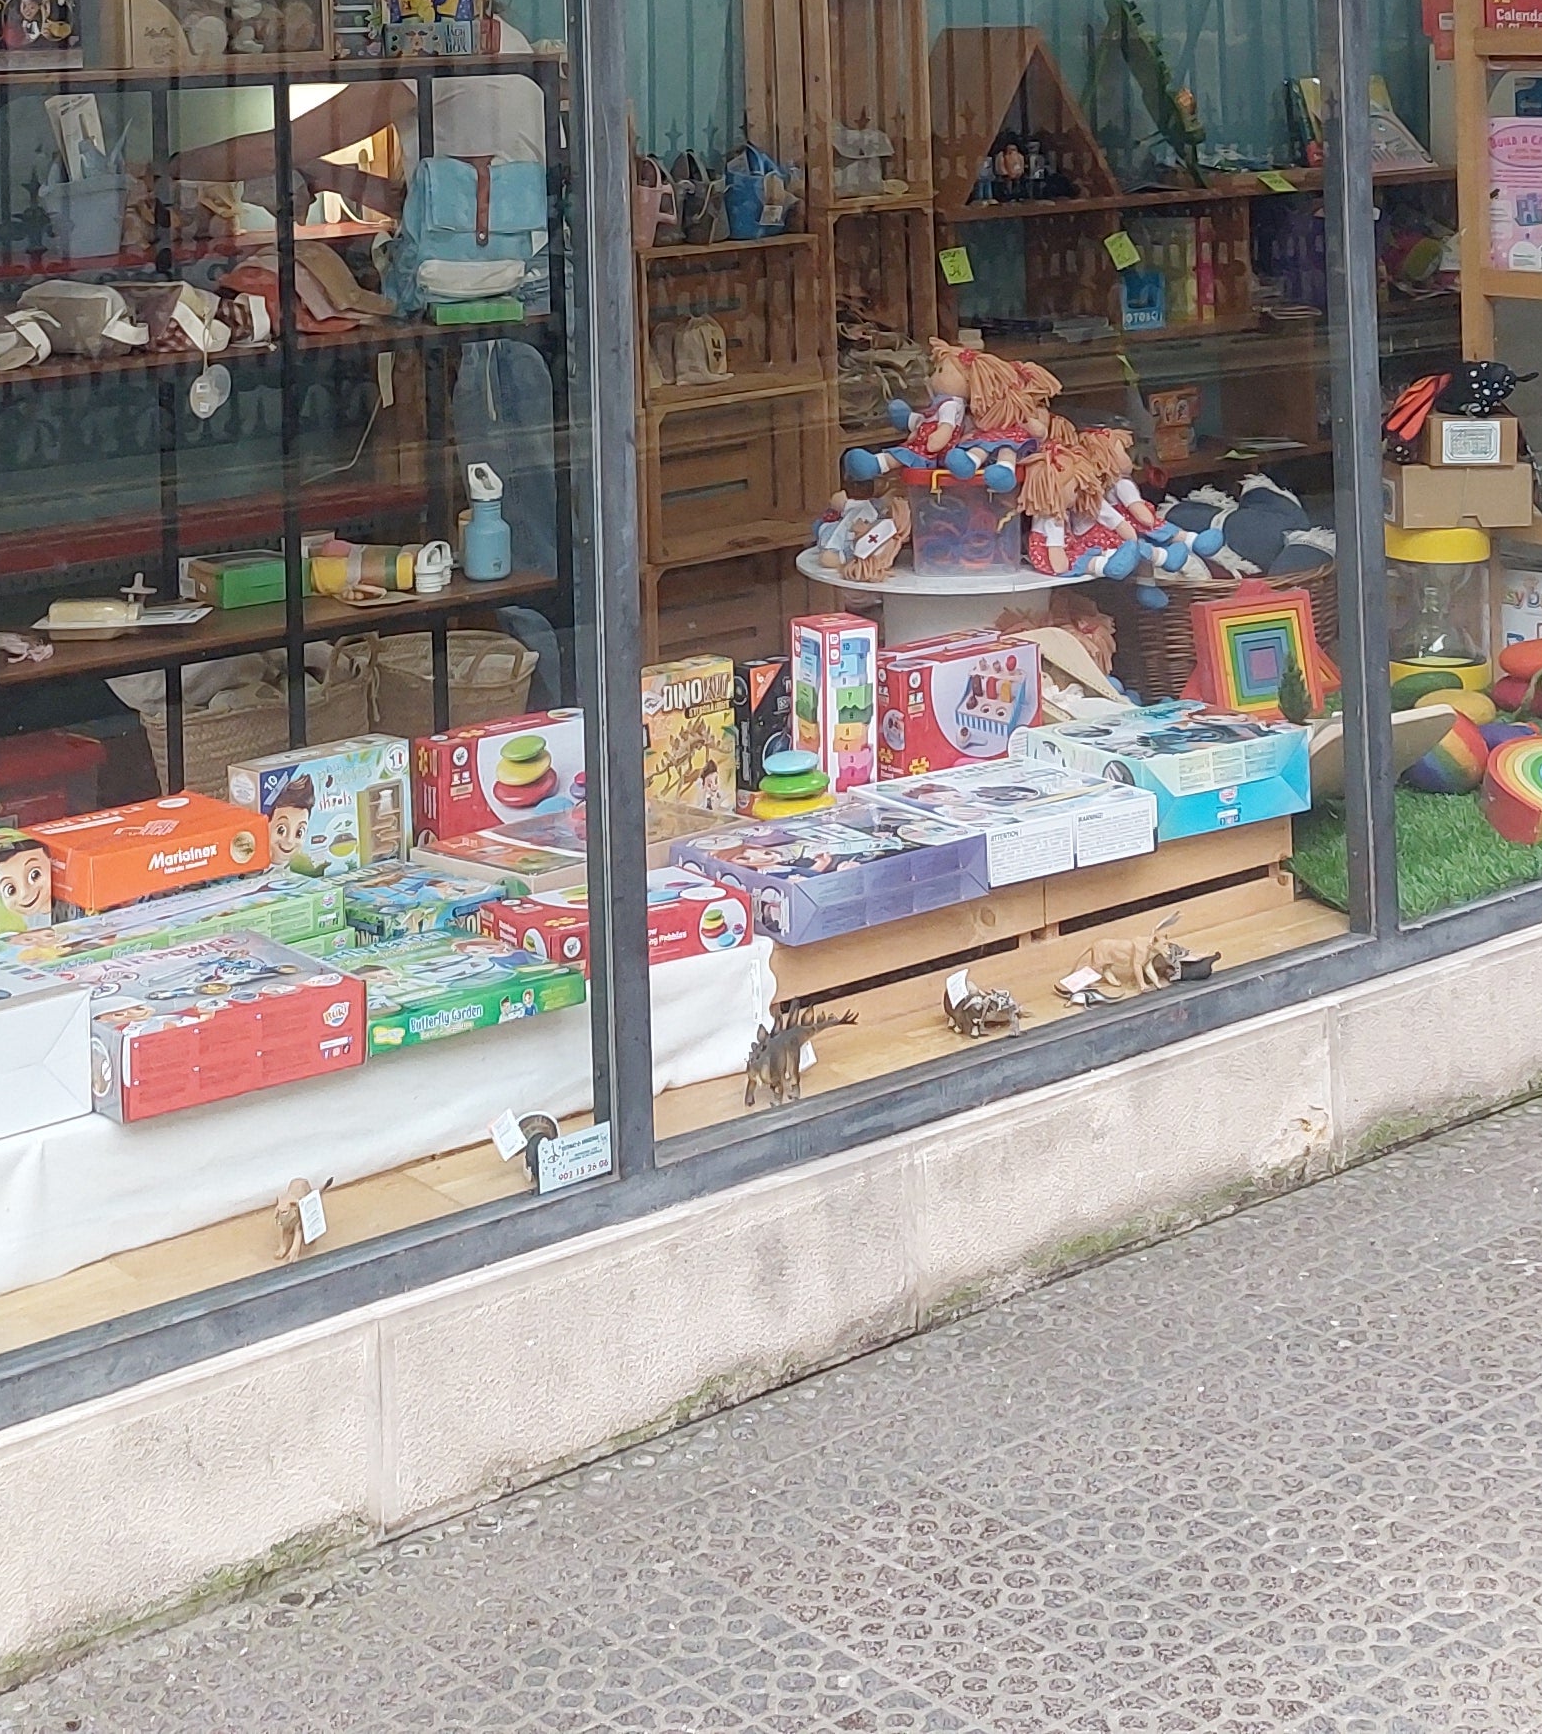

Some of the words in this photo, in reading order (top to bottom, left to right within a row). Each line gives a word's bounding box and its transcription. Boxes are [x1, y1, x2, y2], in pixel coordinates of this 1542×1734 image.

[264, 774, 278, 791] 10
[100, 954, 149, 972] AIR
[150, 936, 236, 959] POWER
[409, 1010, 450, 1034] Butterfly
[451, 1004, 483, 1024] Garden
